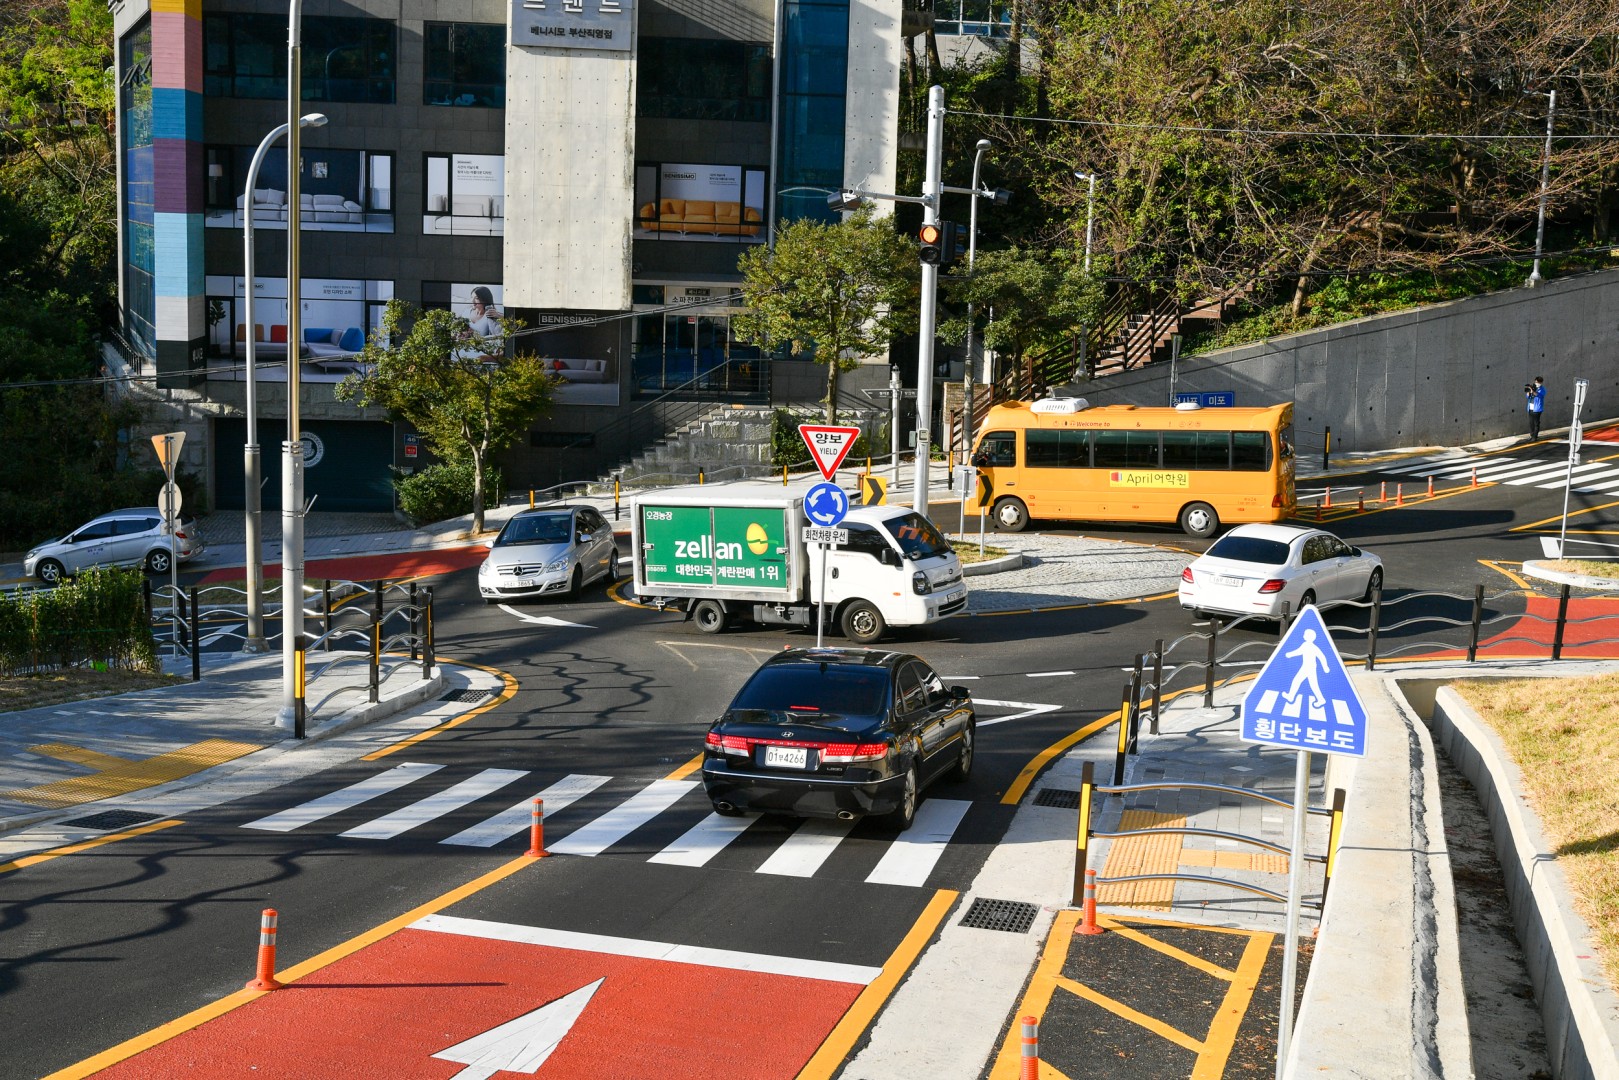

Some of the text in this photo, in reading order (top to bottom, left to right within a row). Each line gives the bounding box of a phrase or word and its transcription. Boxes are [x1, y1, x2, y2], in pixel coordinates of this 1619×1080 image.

[530, 25, 613, 40] 베니시모 부산직영점
[541, 315, 593, 323] BENISSIMO
[1208, 395, 1226, 406] 미포
[815, 433, 842, 444] 양보
[819, 447, 838, 455] YIELD
[1126, 473, 1187, 486] April어학원
[646, 511, 673, 521] 오경농장
[675, 564, 713, 577] 대한민국
[717, 566, 756, 579] 계란판매
[1254, 717, 1355, 750] 횡단보도
